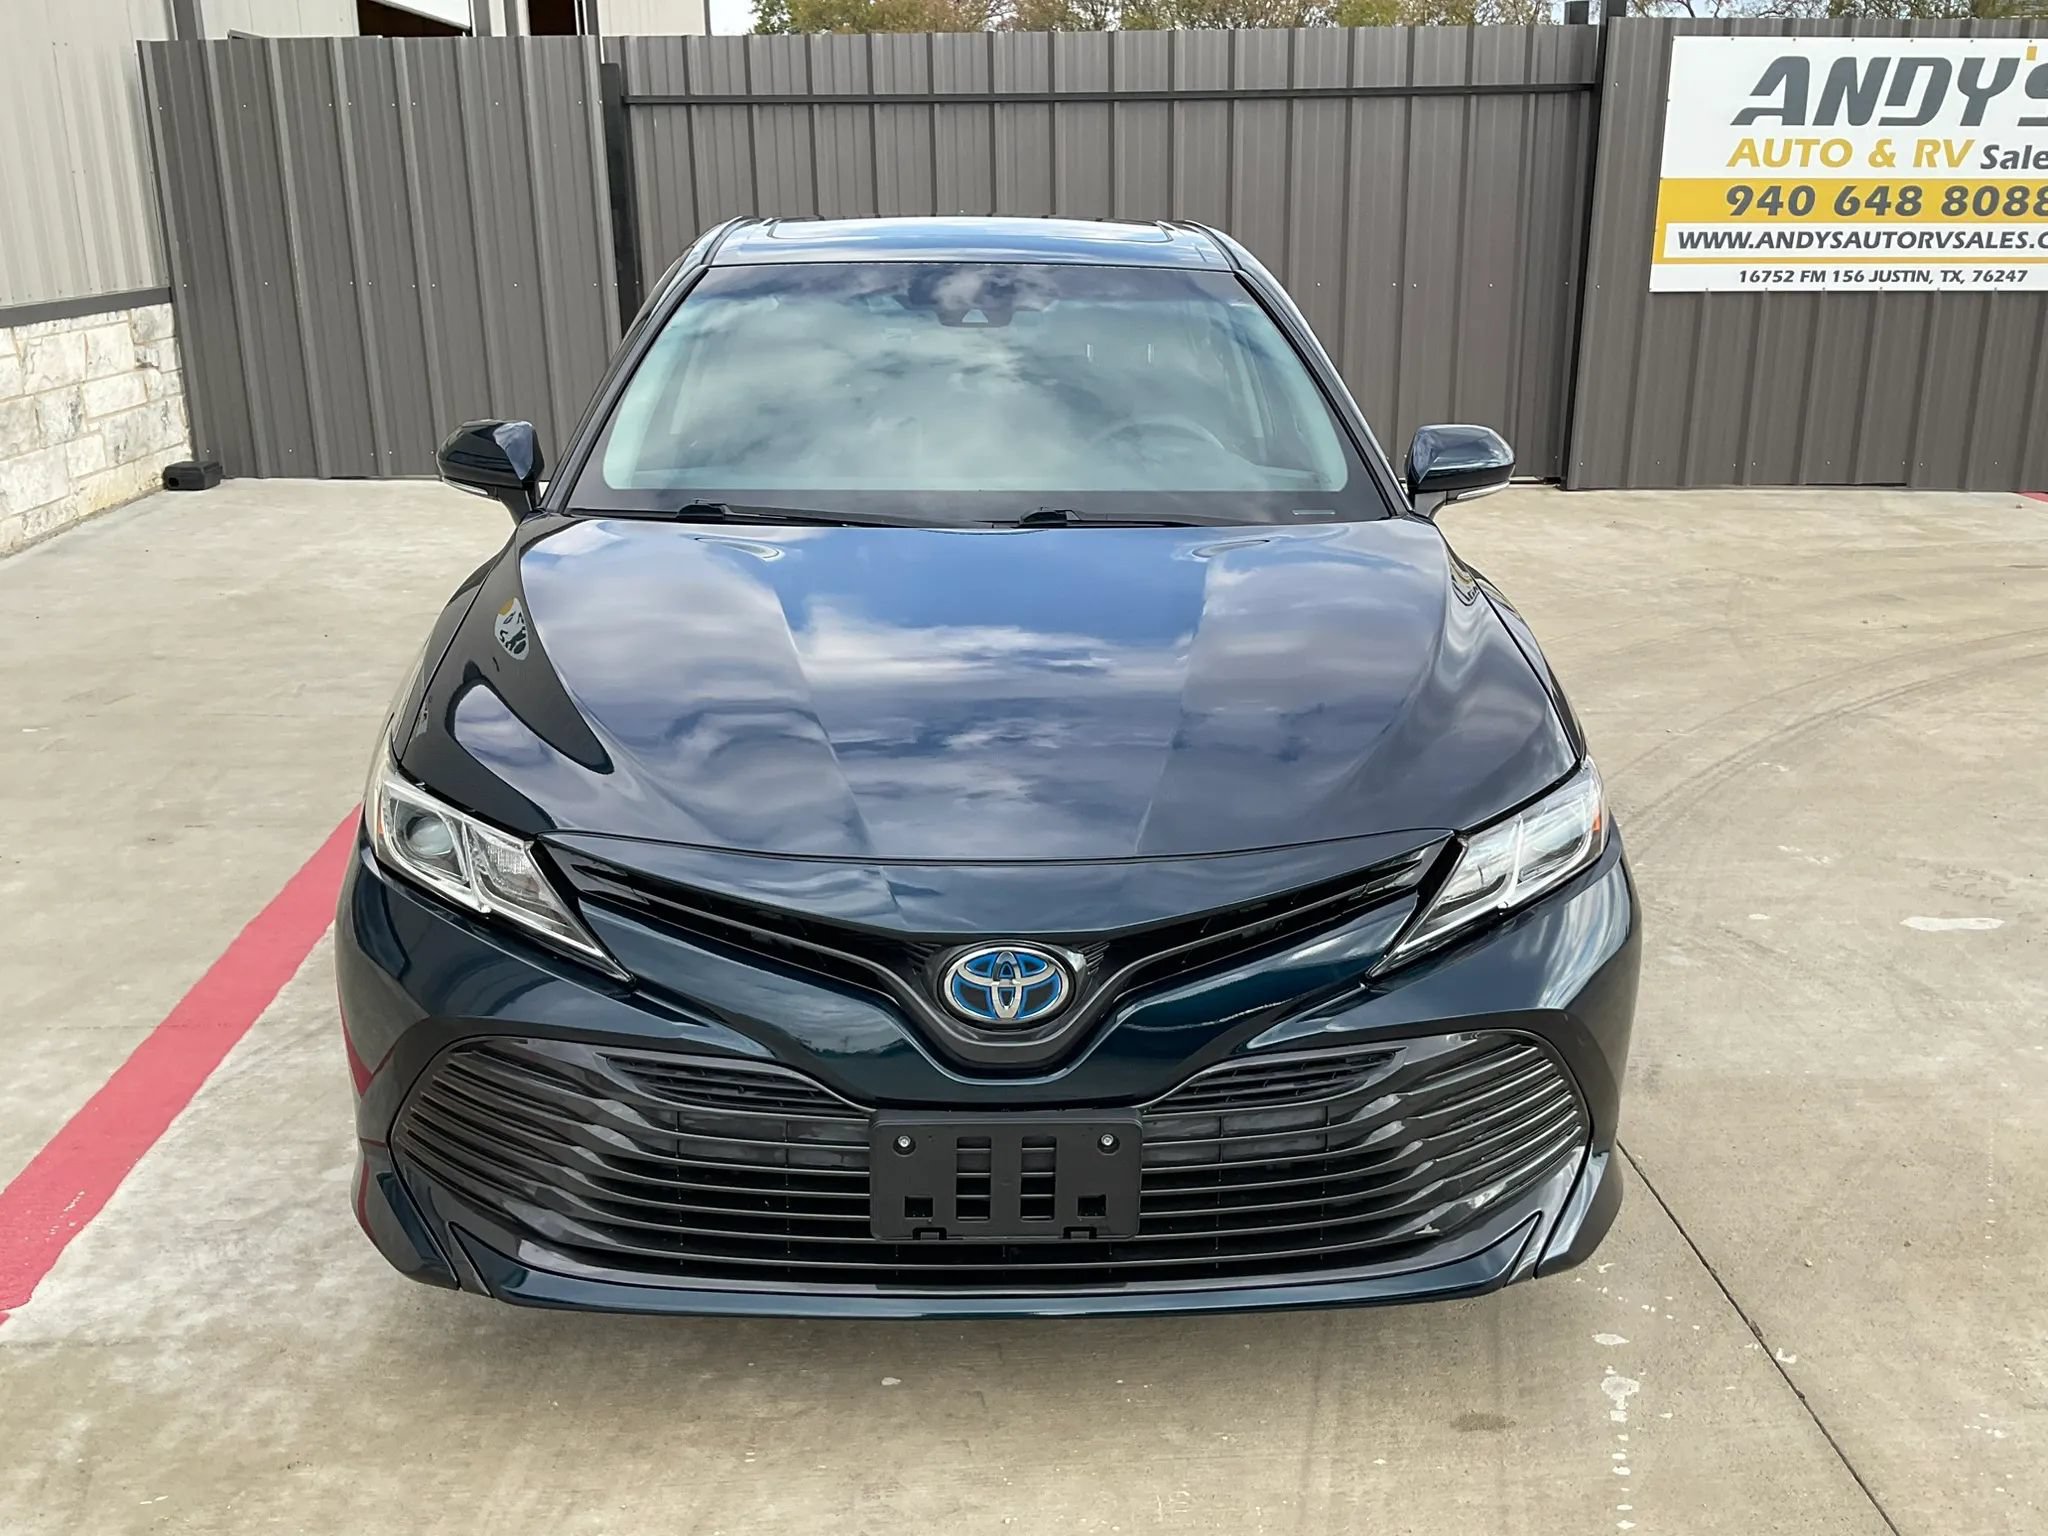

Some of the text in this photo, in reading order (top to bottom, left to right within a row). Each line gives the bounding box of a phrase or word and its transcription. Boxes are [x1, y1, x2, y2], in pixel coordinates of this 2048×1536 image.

[1726, 138, 1854, 168] AUTO
[1868, 138, 1896, 168] &
[1913, 138, 1976, 168] RV
[1726, 185, 2048, 217] 940 648 8088
[1739, 269, 2028, 285] 16752 FM 156 JUSTIN, TX, 76247
